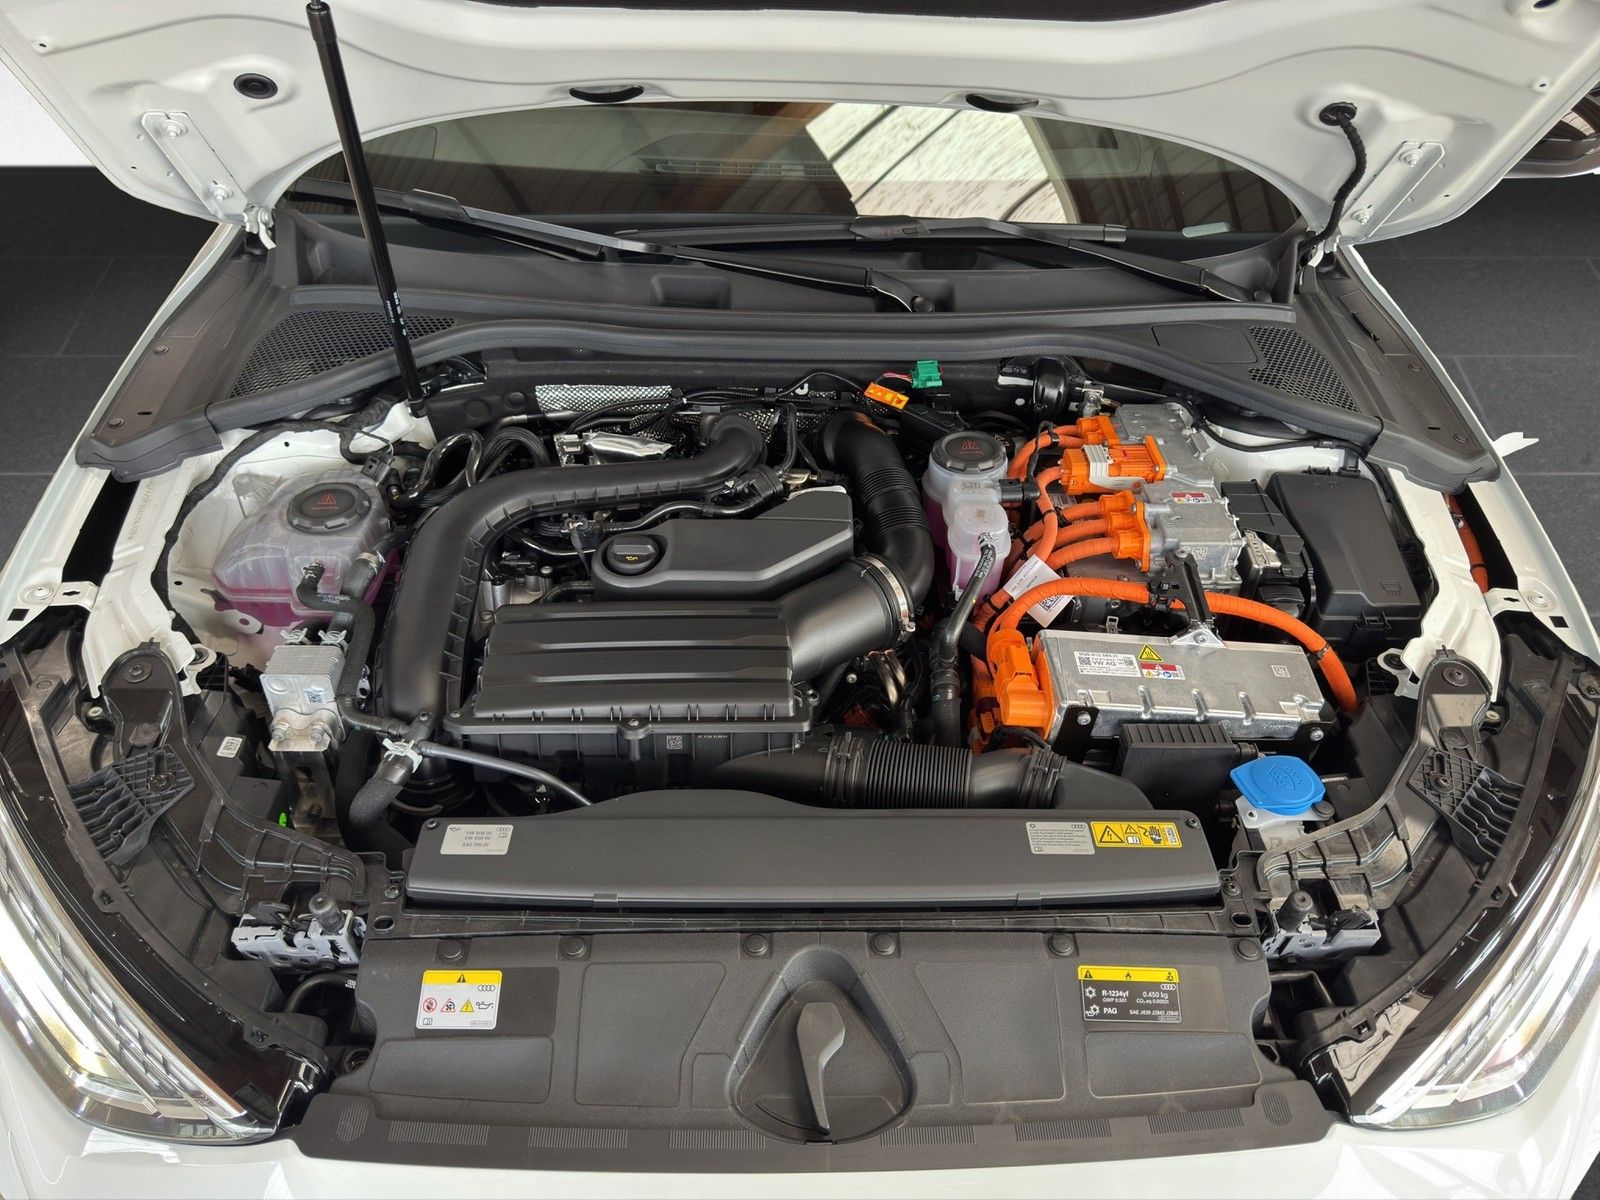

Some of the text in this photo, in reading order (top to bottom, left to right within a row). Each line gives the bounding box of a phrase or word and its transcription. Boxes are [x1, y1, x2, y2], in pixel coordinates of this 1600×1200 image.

[1102, 990, 1129, 998] R-1234yf
[1160, 991, 1169, 1000] kg
[1103, 1007, 1118, 1015] PAG
